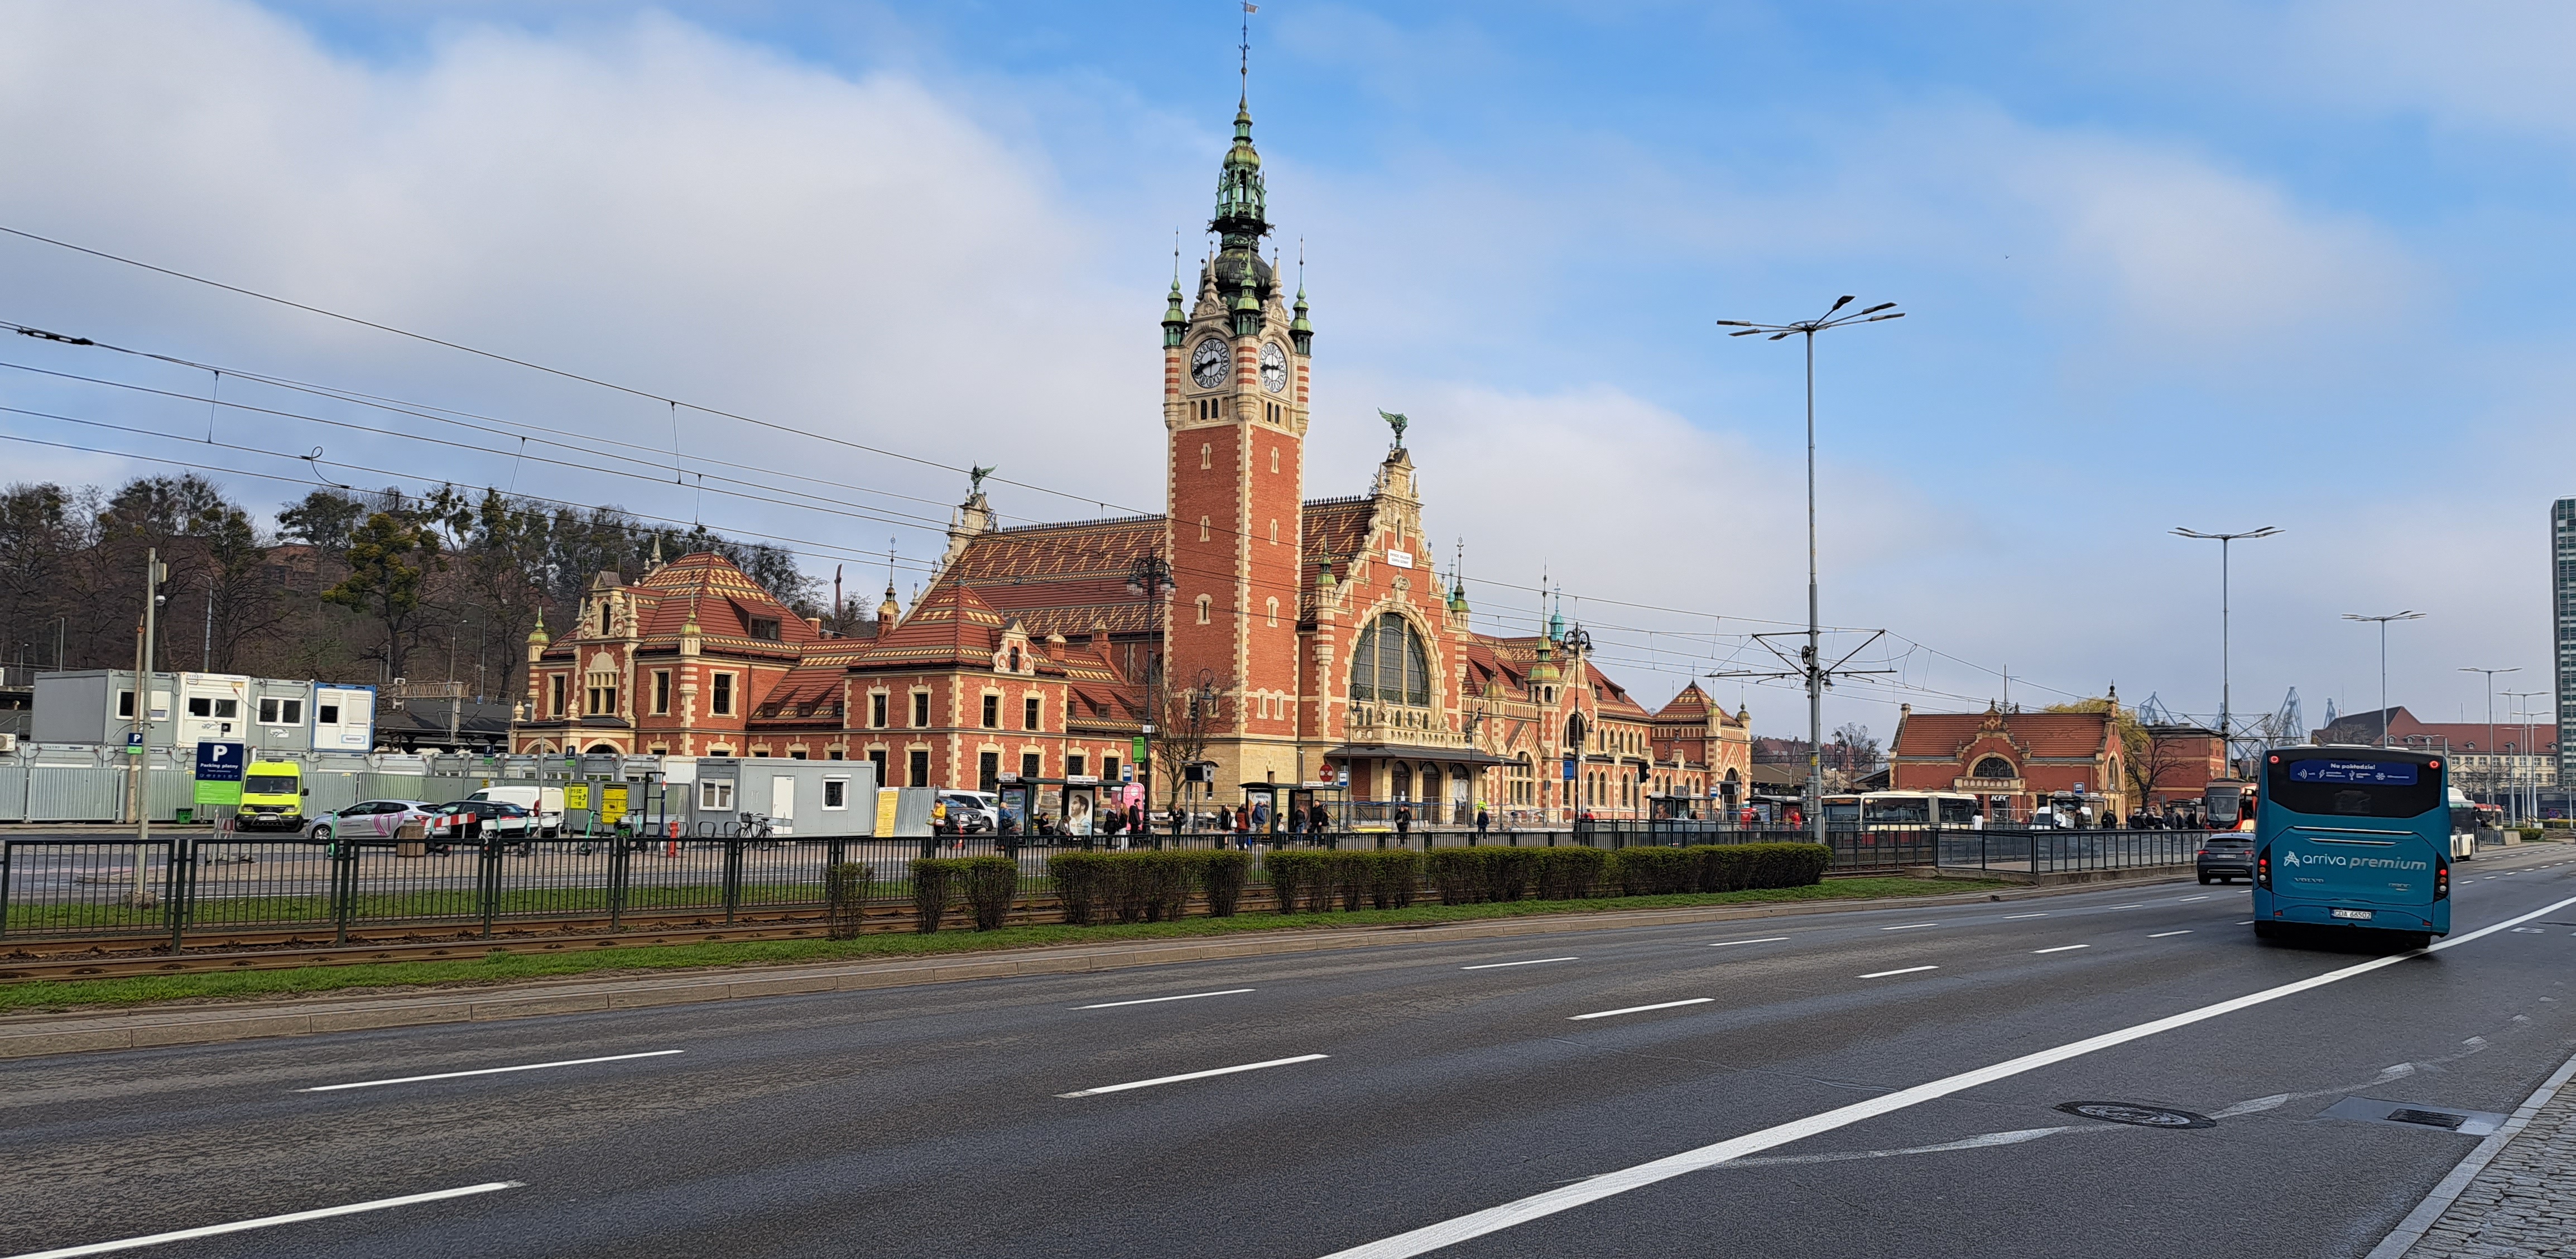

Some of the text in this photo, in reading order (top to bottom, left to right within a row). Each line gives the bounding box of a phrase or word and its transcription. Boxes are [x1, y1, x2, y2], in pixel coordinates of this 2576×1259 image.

[134, 734, 141, 742] P
[213, 744, 228, 762] P
[2303, 854, 2426, 870] arriva premium
